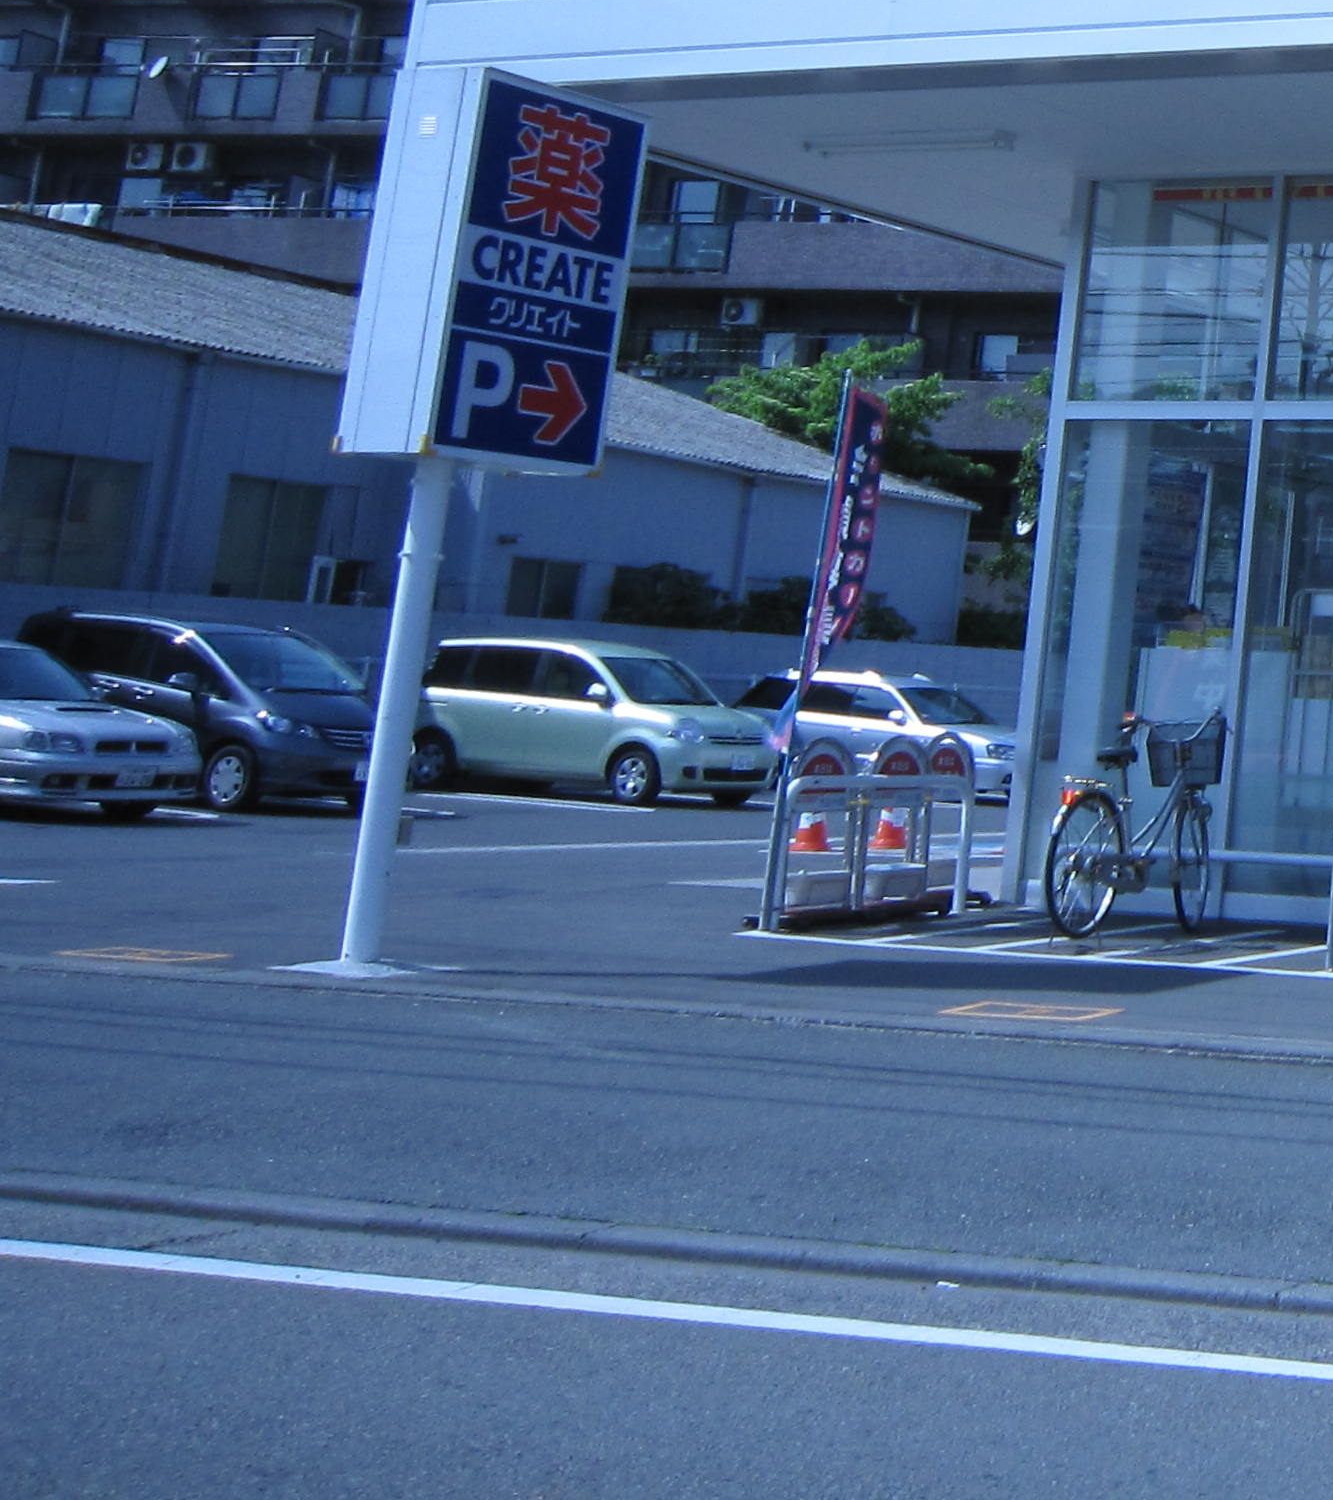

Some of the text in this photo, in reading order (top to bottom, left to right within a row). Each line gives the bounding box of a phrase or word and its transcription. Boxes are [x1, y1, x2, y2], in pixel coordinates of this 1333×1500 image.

[502, 103, 611, 241] 薬
[472, 234, 614, 306] CREATE
[489, 296, 582, 339] クリエイト
[450, 339, 515, 440] P
